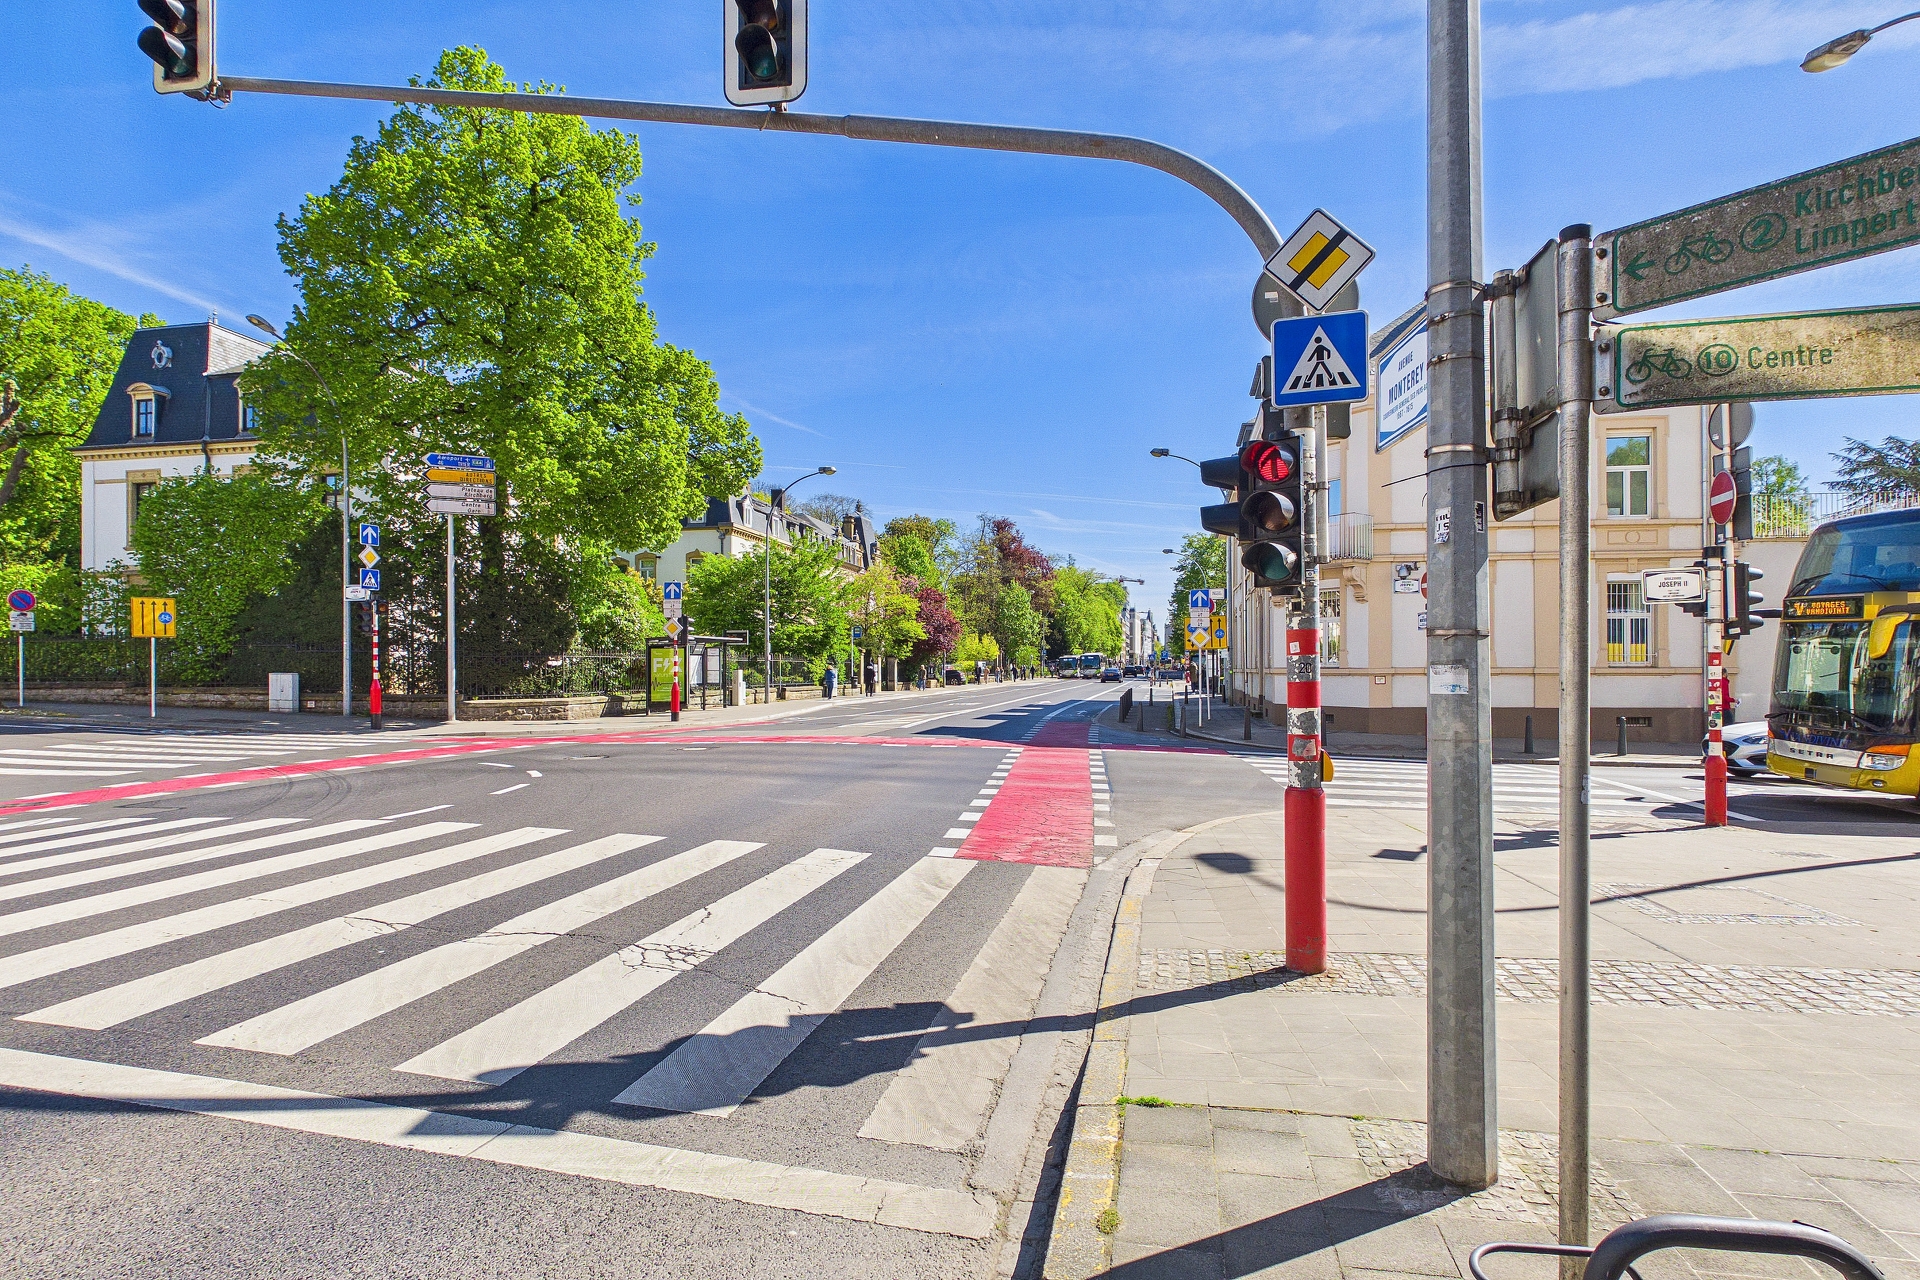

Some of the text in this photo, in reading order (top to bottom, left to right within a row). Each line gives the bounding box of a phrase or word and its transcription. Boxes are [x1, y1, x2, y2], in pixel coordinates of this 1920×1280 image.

[1751, 164, 1920, 248] 2 Kirchbe
[1398, 351, 1413, 372] AVENUE
[1703, 344, 1833, 369] 10 Centre
[1388, 362, 1424, 405] MONTEREY
[1658, 580, 1682, 588] JOSEPH
[1299, 662, 1311, 673] 20
[1789, 747, 1834, 760] SETRA
